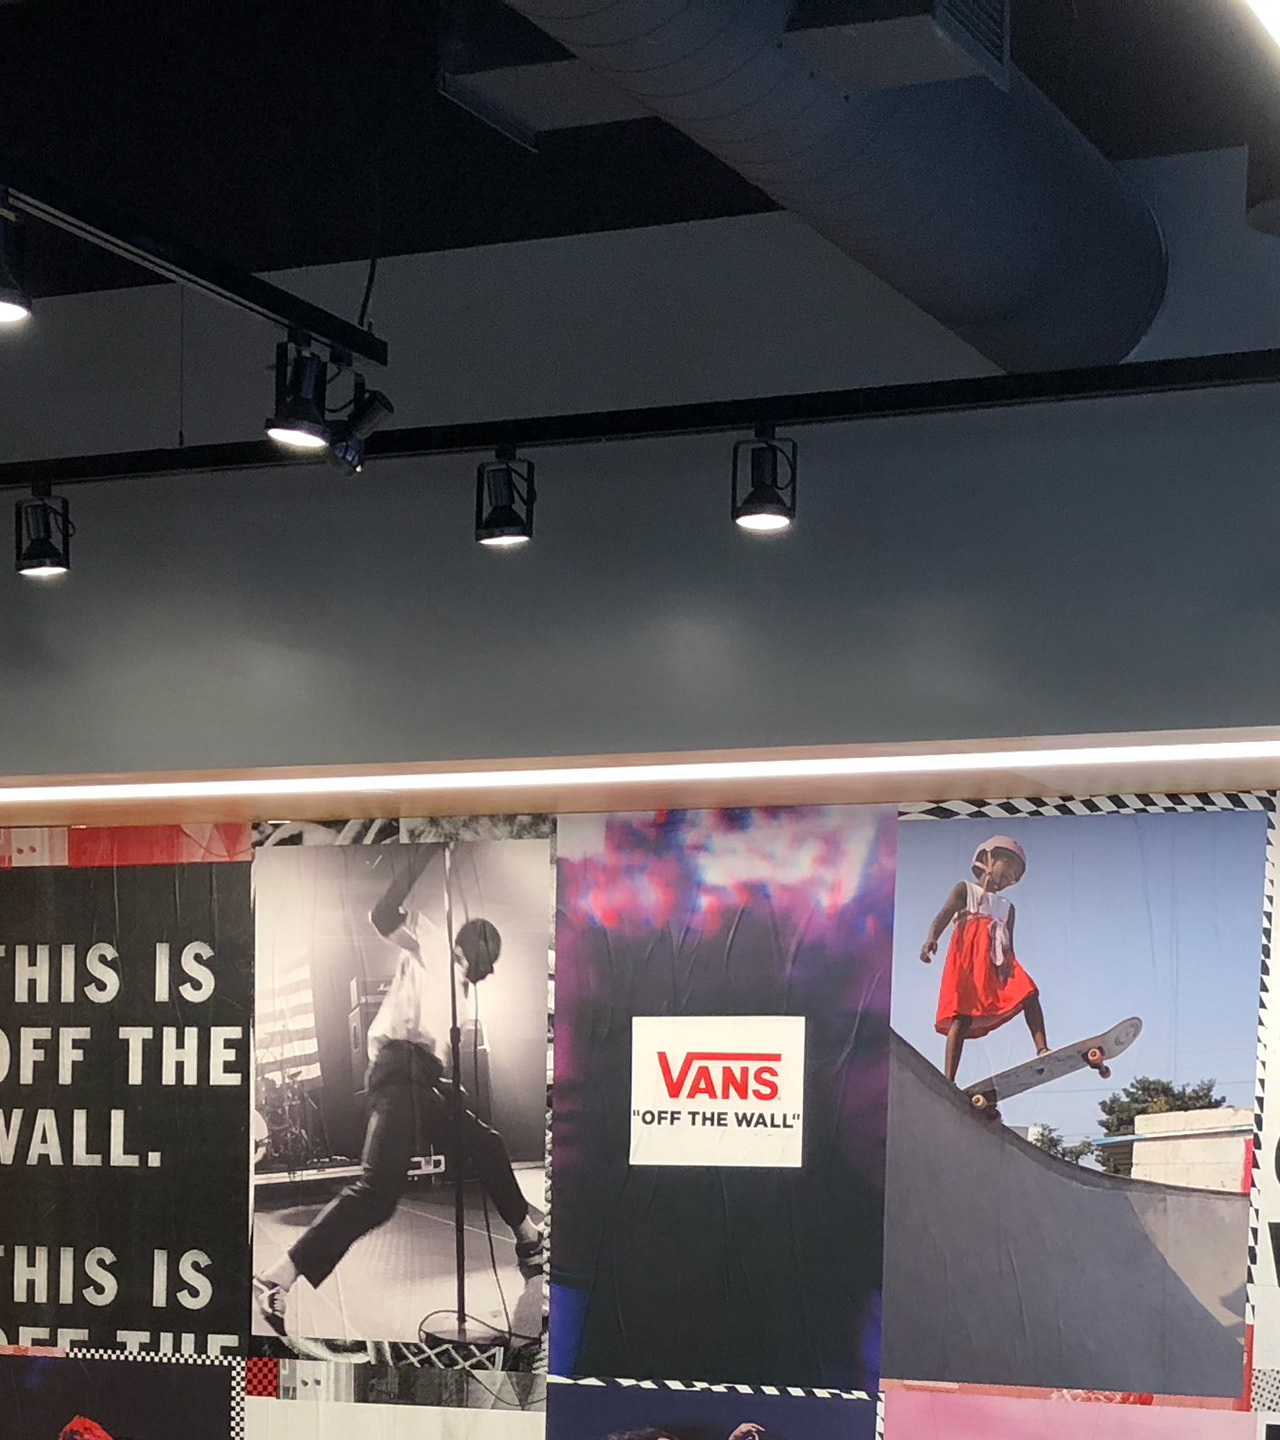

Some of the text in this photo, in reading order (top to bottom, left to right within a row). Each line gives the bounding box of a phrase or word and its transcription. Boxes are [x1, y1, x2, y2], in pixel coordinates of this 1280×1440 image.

[155, 942, 216, 1003] IS
[119, 1027, 242, 1086] THE
[657, 1051, 781, 1101] VANS
[633, 1110, 800, 1128] "OFF THE WALL"
[153, 1249, 214, 1310] IS
